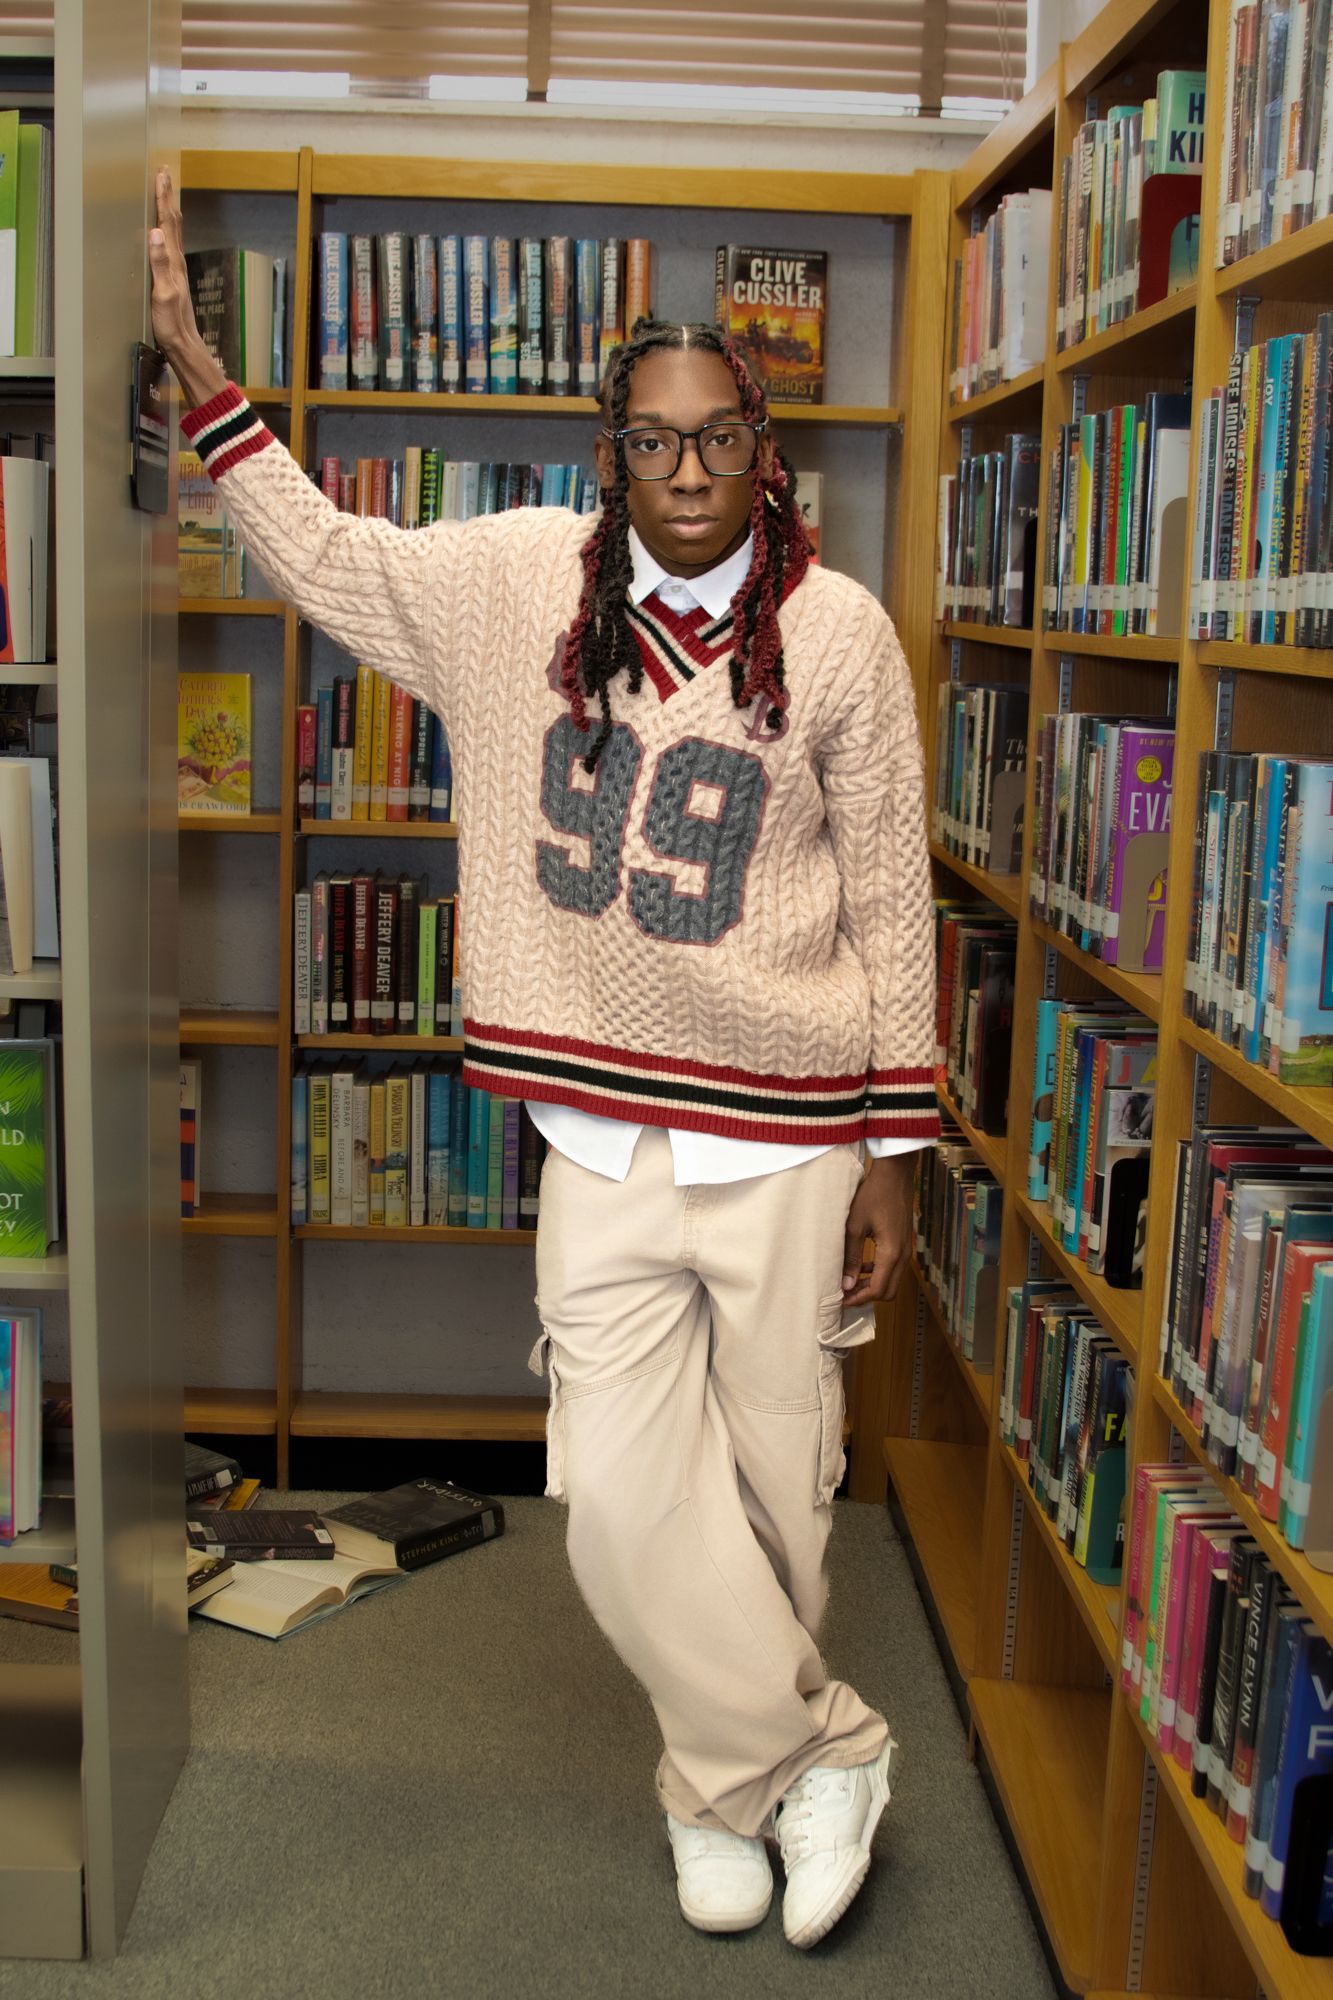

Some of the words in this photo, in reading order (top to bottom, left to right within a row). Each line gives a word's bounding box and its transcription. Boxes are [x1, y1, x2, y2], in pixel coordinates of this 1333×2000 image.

[1081, 142, 1093, 196] DAVID
[327, 238, 340, 269] CLIVE
[358, 238, 371, 271] CLIVE
[388, 236, 401, 266] CLIVE
[444, 240, 457, 271] CLIVE
[470, 241, 483, 273] CLIVE
[498, 240, 510, 268] CLIVE
[528, 242, 541, 276] CLIVE
[604, 246, 616, 274] CLIVE
[217, 276, 224, 286] TO
[750, 257, 806, 284] CLIVE
[198, 289, 223, 302] DISRUPT
[327, 272, 340, 321] CUSSLER
[358, 272, 371, 322] CUSSLER
[388, 268, 401, 318] CUSSLER
[444, 274, 457, 323] CUSSLER
[470, 276, 484, 325] CUSSLER
[528, 278, 541, 328] CUSSLER
[603, 277, 616, 329] CUSSLER
[733, 281, 821, 309] CUSSLER
[196, 304, 208, 316] THE
[209, 303, 225, 315] PEACE
[771, 378, 816, 396] GHOST
[1228, 352, 1241, 397] SAFE
[1265, 380, 1275, 406] JOY
[1223, 403, 1239, 468] HOUSES
[1298, 384, 1310, 471] JOSEPH
[422, 453, 437, 505] MASTER
[1273, 470, 1283, 513] SHE'S
[1271, 518, 1281, 548] NOT
[393, 704, 404, 749] TALKING
[394, 751, 402, 764] AT
[417, 731, 426, 763] SPRING
[191, 802, 247, 812] CRAWFORD
[1111, 773, 1122, 831] EVANOVICH
[1278, 771, 1293, 855] FANNIE
[536, 713, 772, 947] 99
[1207, 836, 1216, 883] Silent
[334, 886, 345, 917] JEFFERY
[355, 884, 366, 915] JEFFERY
[1272, 862, 1285, 931] FLAGG
[297, 904, 308, 952] JEFFERY
[378, 892, 393, 943] JEFFERY
[334, 920, 345, 952] DEAVER
[355, 918, 366, 950] DEAVER
[334, 955, 344, 967] THE
[376, 946, 391, 992] DEAVER
[297, 956, 308, 999] DEAVER
[1065, 1030, 1073, 1061] Janet
[1071, 1047, 1079, 1074] JANET
[313, 1084, 326, 1101] DON
[1061, 1064, 1071, 1116] Evanovich
[1089, 1058, 1099, 1102] JANET
[332, 1088, 340, 1139] DELINSKY
[391, 1084, 404, 1116] BARBARA
[313, 1104, 326, 1147] DELILLO
[391, 1118, 403, 1147] DELINSKY
[1084, 1104, 1096, 1181] EVANOVICH
[313, 1154, 327, 1190] LIBRA
[337, 1148, 345, 1175] BEFORE
[1263, 1268, 1272, 1289] TO
[1260, 1291, 1270, 1320] SLIP
[1079, 1337, 1088, 1368] LINDA
[1073, 1373, 1085, 1420] FAIRSTEIN
[191, 1479, 207, 1496] PLACE
[416, 1480, 483, 1508] OUTSIDER
[400, 1539, 438, 1561] STEPHEN
[438, 1533, 459, 1547] KING
[1170, 1578, 1178, 1602] PINK
[1246, 1582, 1263, 1650] VINCE
[1239, 1654, 1256, 1728] FLYNN
